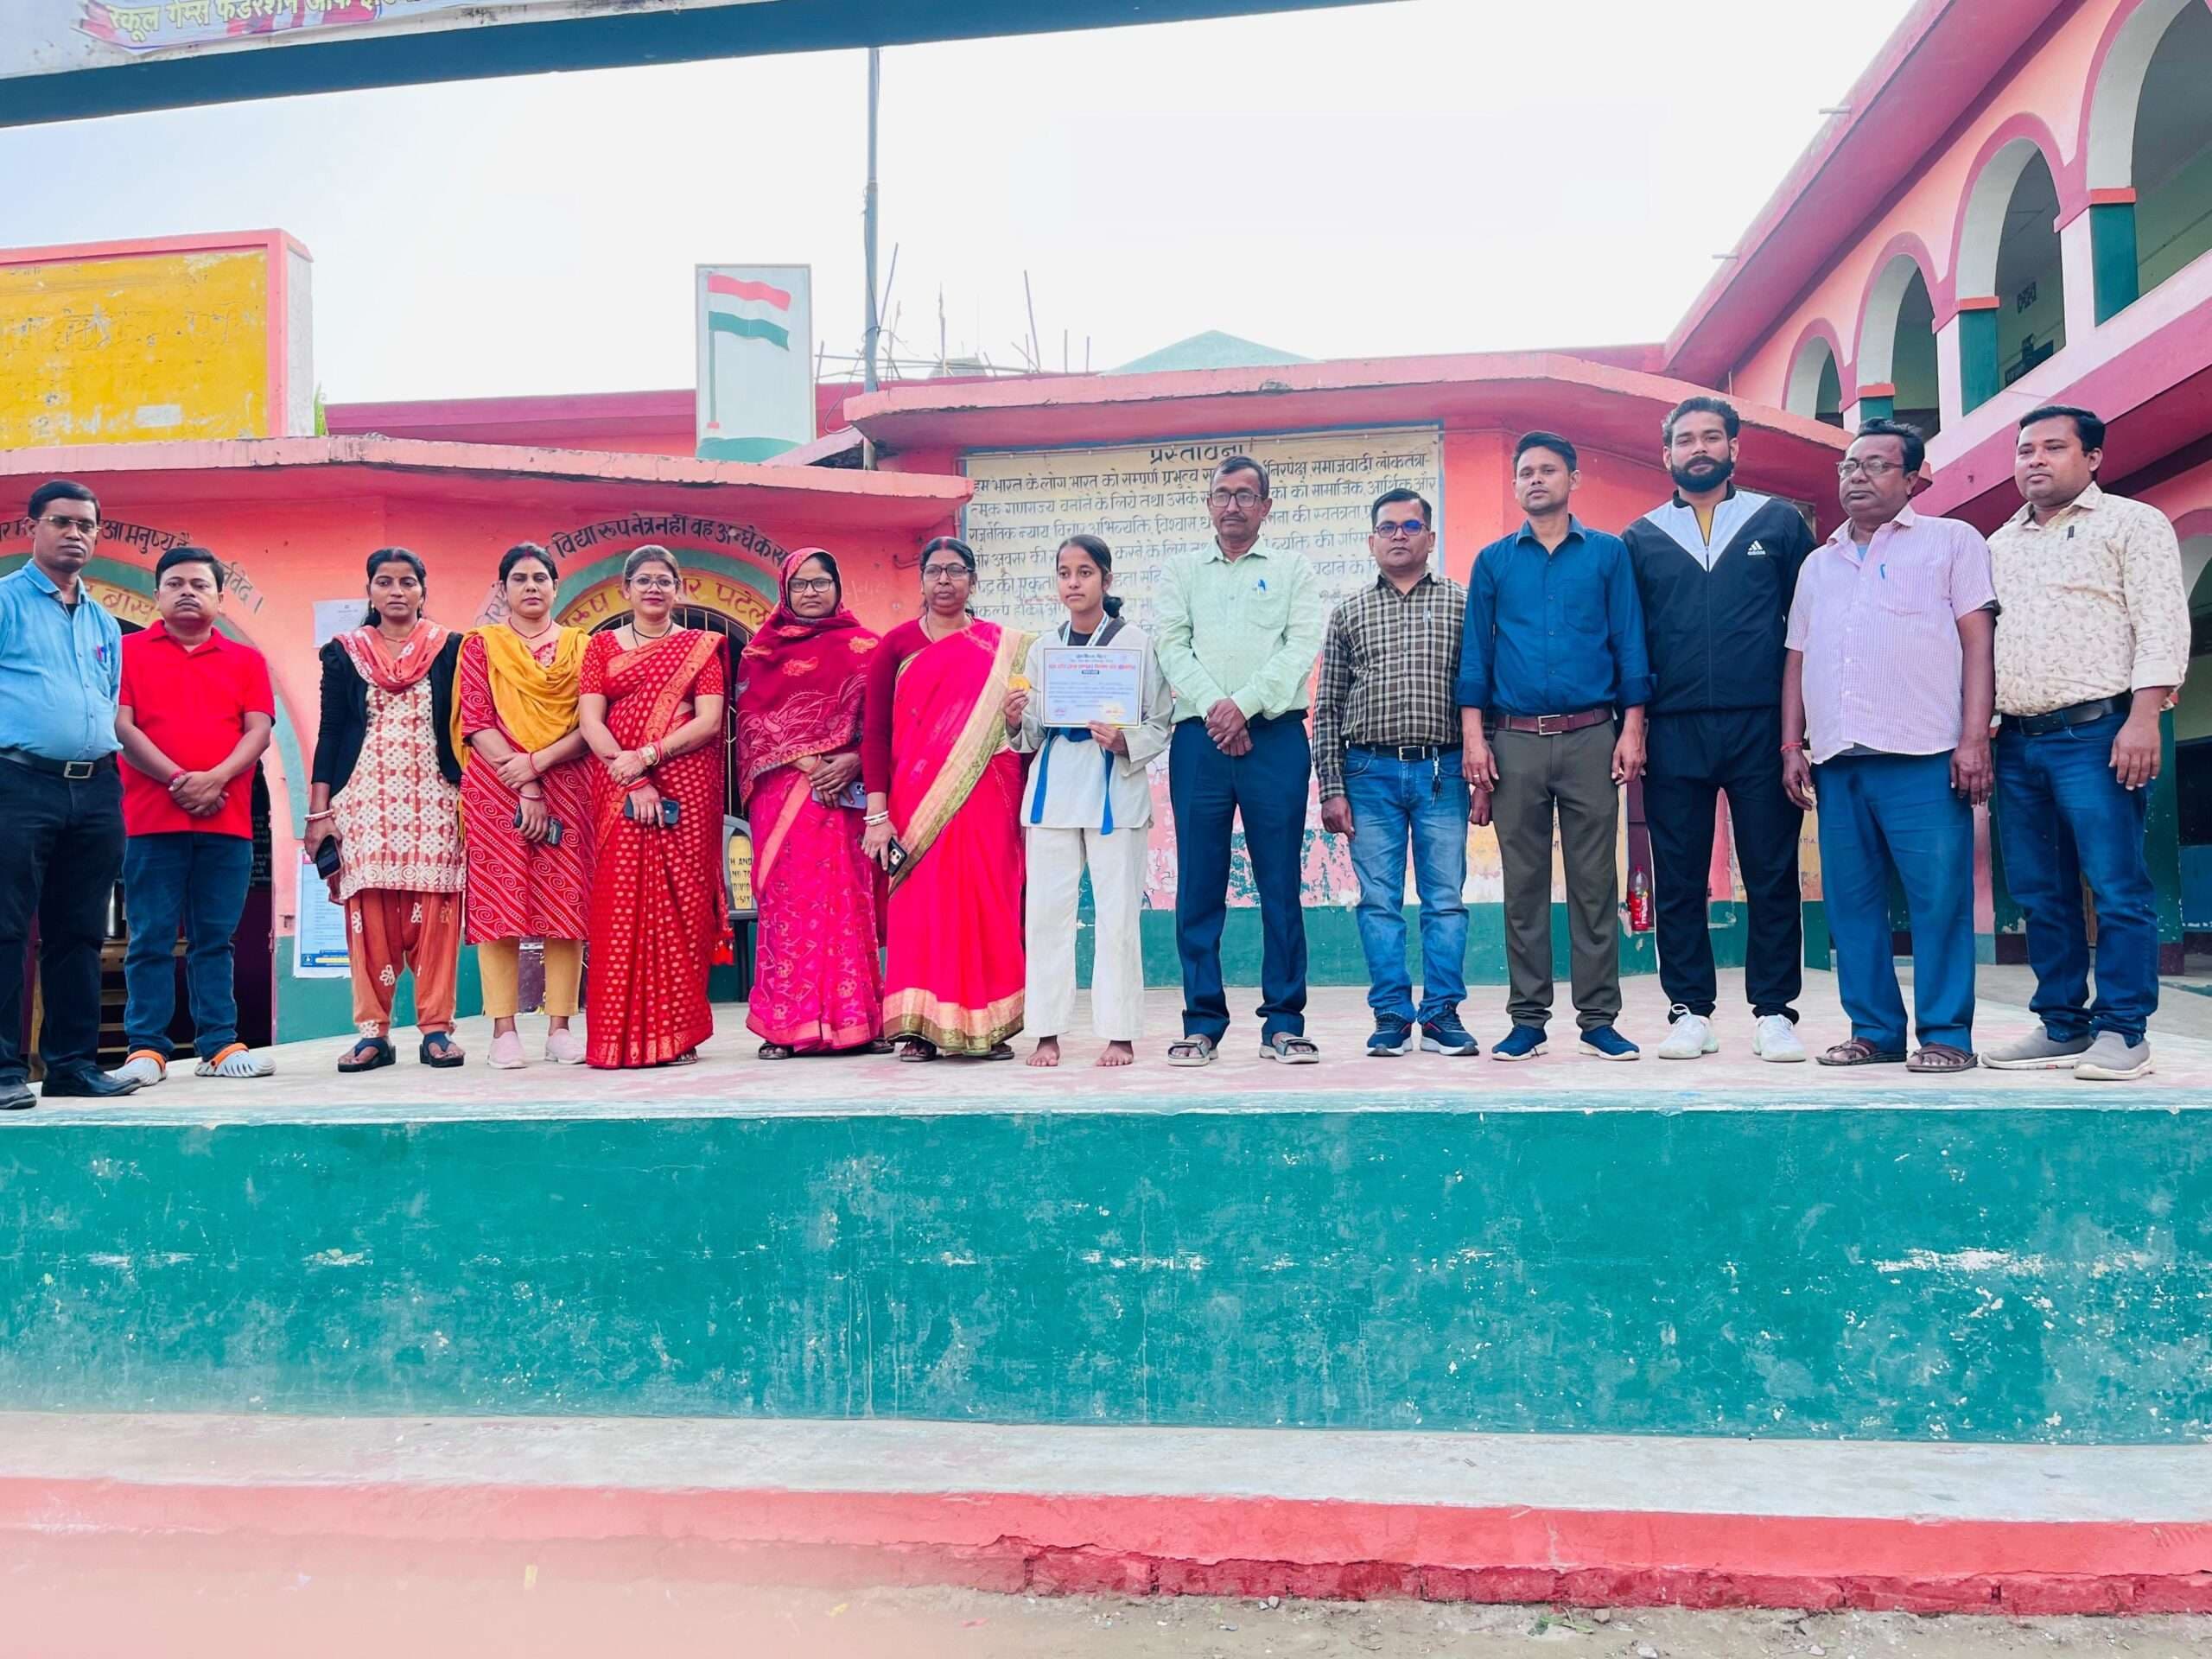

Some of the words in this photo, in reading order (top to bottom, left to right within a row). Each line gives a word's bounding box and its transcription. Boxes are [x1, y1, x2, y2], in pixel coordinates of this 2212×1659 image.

[107, 5, 160, 41] स्कूल
[1150, 444, 1243, 464] प्रस्तावना
[993, 478, 1022, 494] भारत
[1069, 474, 1098, 492] भारत
[1102, 468, 1119, 489] को
[1161, 469, 1198, 489] प्रभुत्व
[1140, 493, 1163, 509] तथा
[125, 524, 175, 555] मनुष्य
